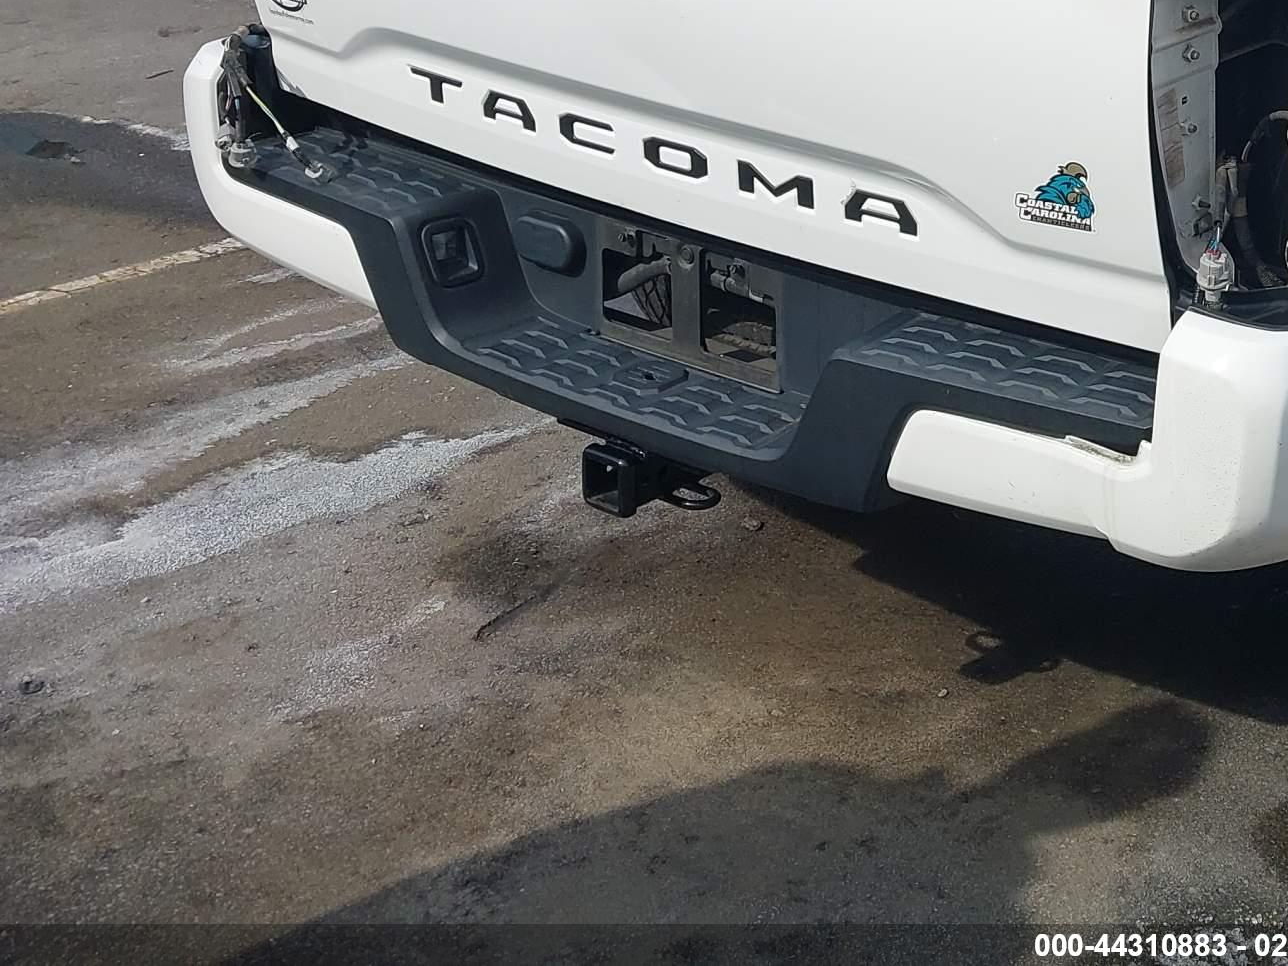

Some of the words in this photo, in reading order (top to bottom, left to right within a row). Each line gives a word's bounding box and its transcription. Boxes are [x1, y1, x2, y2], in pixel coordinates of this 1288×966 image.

[408, 64, 920, 236] TACOMA
[1015, 193, 1079, 214] COASTAL
[1020, 207, 1091, 225] CAROLINA
